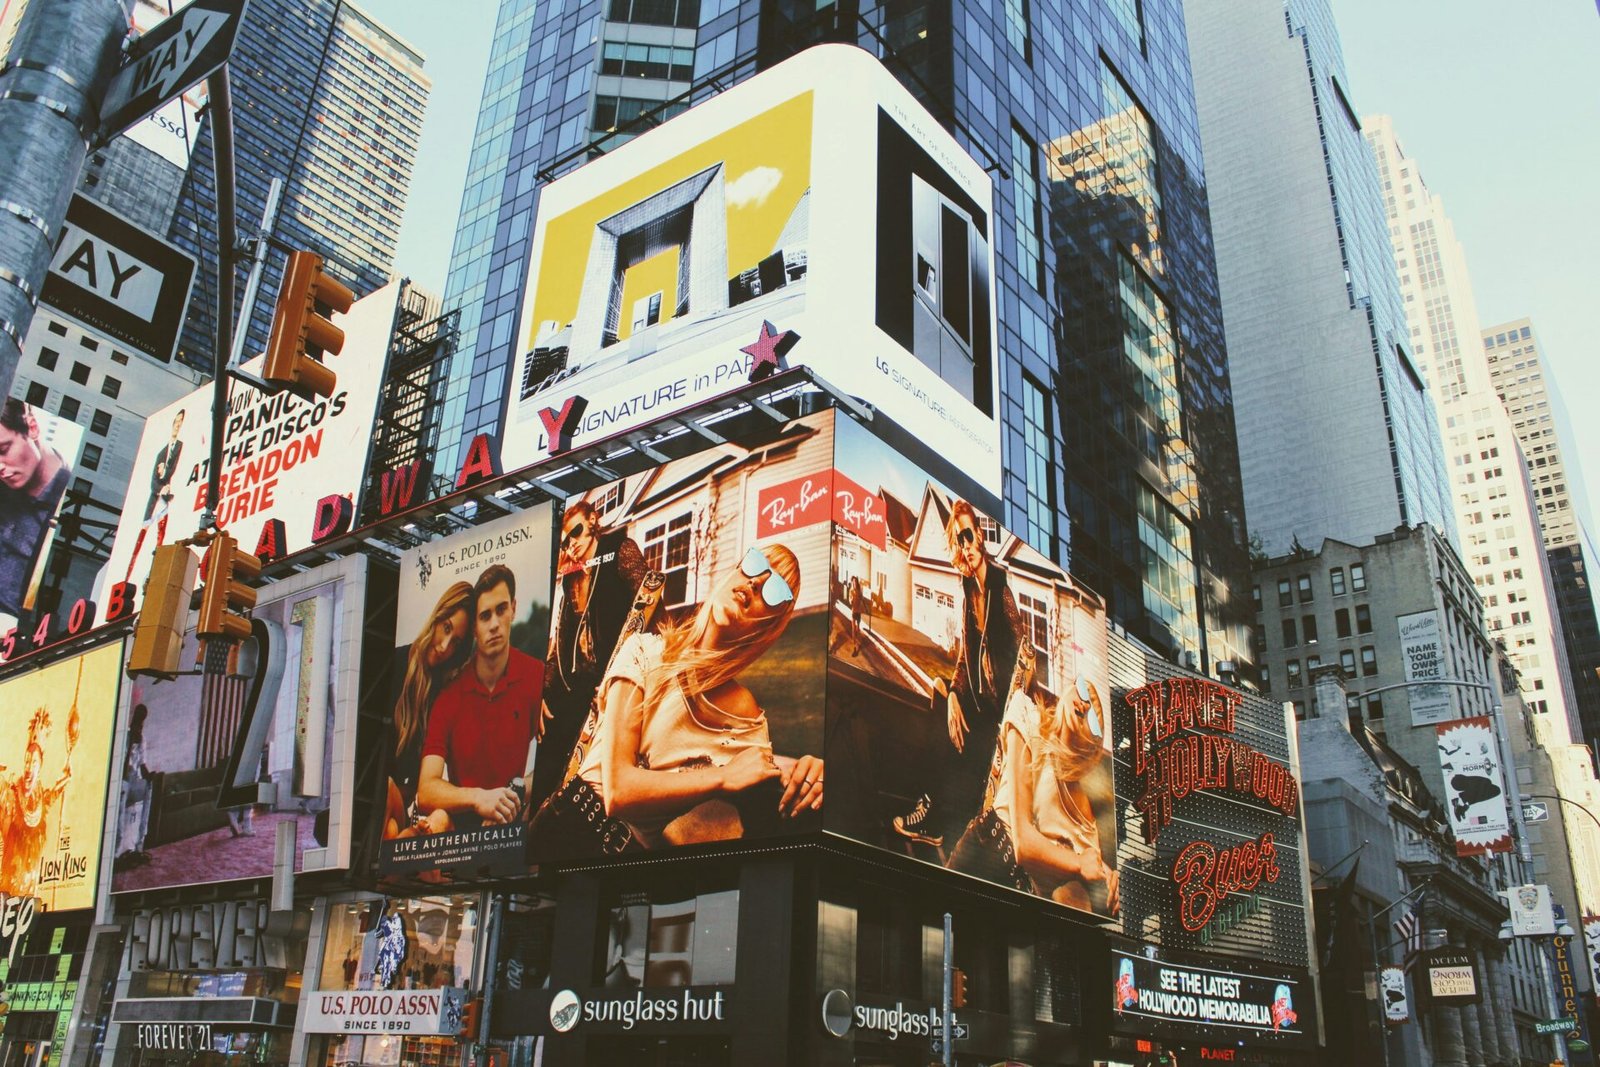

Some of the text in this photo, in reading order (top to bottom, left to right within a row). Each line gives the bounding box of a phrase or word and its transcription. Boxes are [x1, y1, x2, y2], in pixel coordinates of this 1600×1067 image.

[131, 16, 210, 97] WAY
[57, 227, 141, 299] AY
[694, 374, 710, 392] in
[876, 356, 889, 375] LG
[891, 368, 948, 421] SIGNATURE
[225, 391, 303, 443] PANIC
[186, 458, 210, 487] AT
[259, 391, 348, 452] DISCO'S
[193, 428, 324, 512] BRENDON
[216, 478, 278, 529] URIE
[762, 480, 828, 528] Ray-Ban
[836, 491, 883, 529] Ray-Ban
[438, 526, 533, 568] U.S. POLO ASSN.
[455, 553, 507, 575] SINCE 1890
[1407, 642, 1437, 654] NAME
[1410, 651, 1437, 662] YOUR
[1412, 660, 1438, 670] OWN
[1412, 668, 1440, 679] PRICE
[1125, 676, 1243, 776] PLANET
[1137, 733, 1298, 845] HOLLYWOOD
[394, 826, 523, 853] LIVE AUTHENTICALLY
[1160, 968, 1241, 999] SEE THE LATEST
[321, 995, 441, 1016] U.S. POLO ASSN
[584, 989, 725, 1030] sunglass hut
[855, 1001, 958, 1040] sunglass ht
[1138, 988, 1197, 1017] HOLLYWOOD
[1199, 999, 1272, 1025] MEMORABILIA
[138, 1024, 211, 1051] FOREVER 21
[344, 1020, 411, 1031] SINCE 1890
[1536, 1020, 1575, 1034] Broadway
[1201, 1047, 1236, 1062] PLANET
